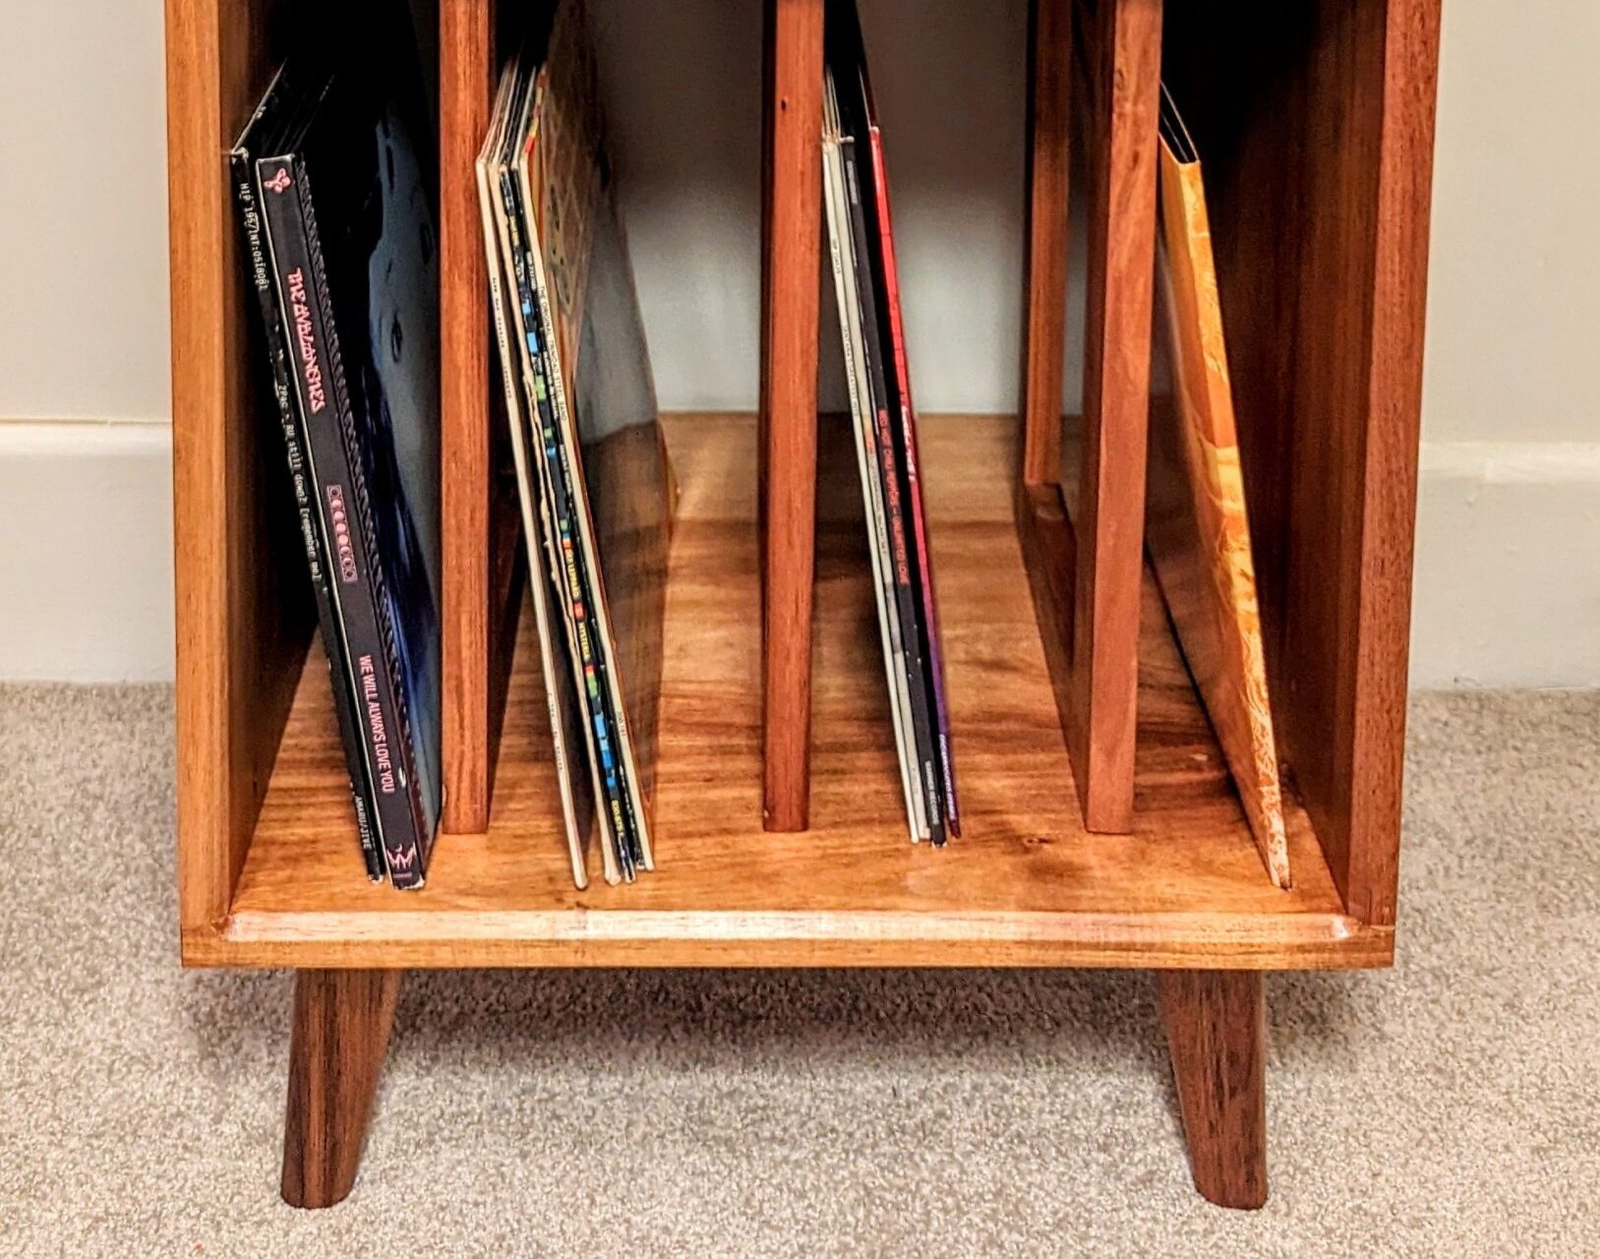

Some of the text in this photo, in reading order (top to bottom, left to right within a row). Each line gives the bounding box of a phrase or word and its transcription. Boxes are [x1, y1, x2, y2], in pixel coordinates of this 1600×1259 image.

[288, 268, 326, 414] THE AVALANCHES
[542, 301, 552, 335] ORIGINAL
[359, 655, 397, 794] WE WILL ALWAYS LOVE YOU
